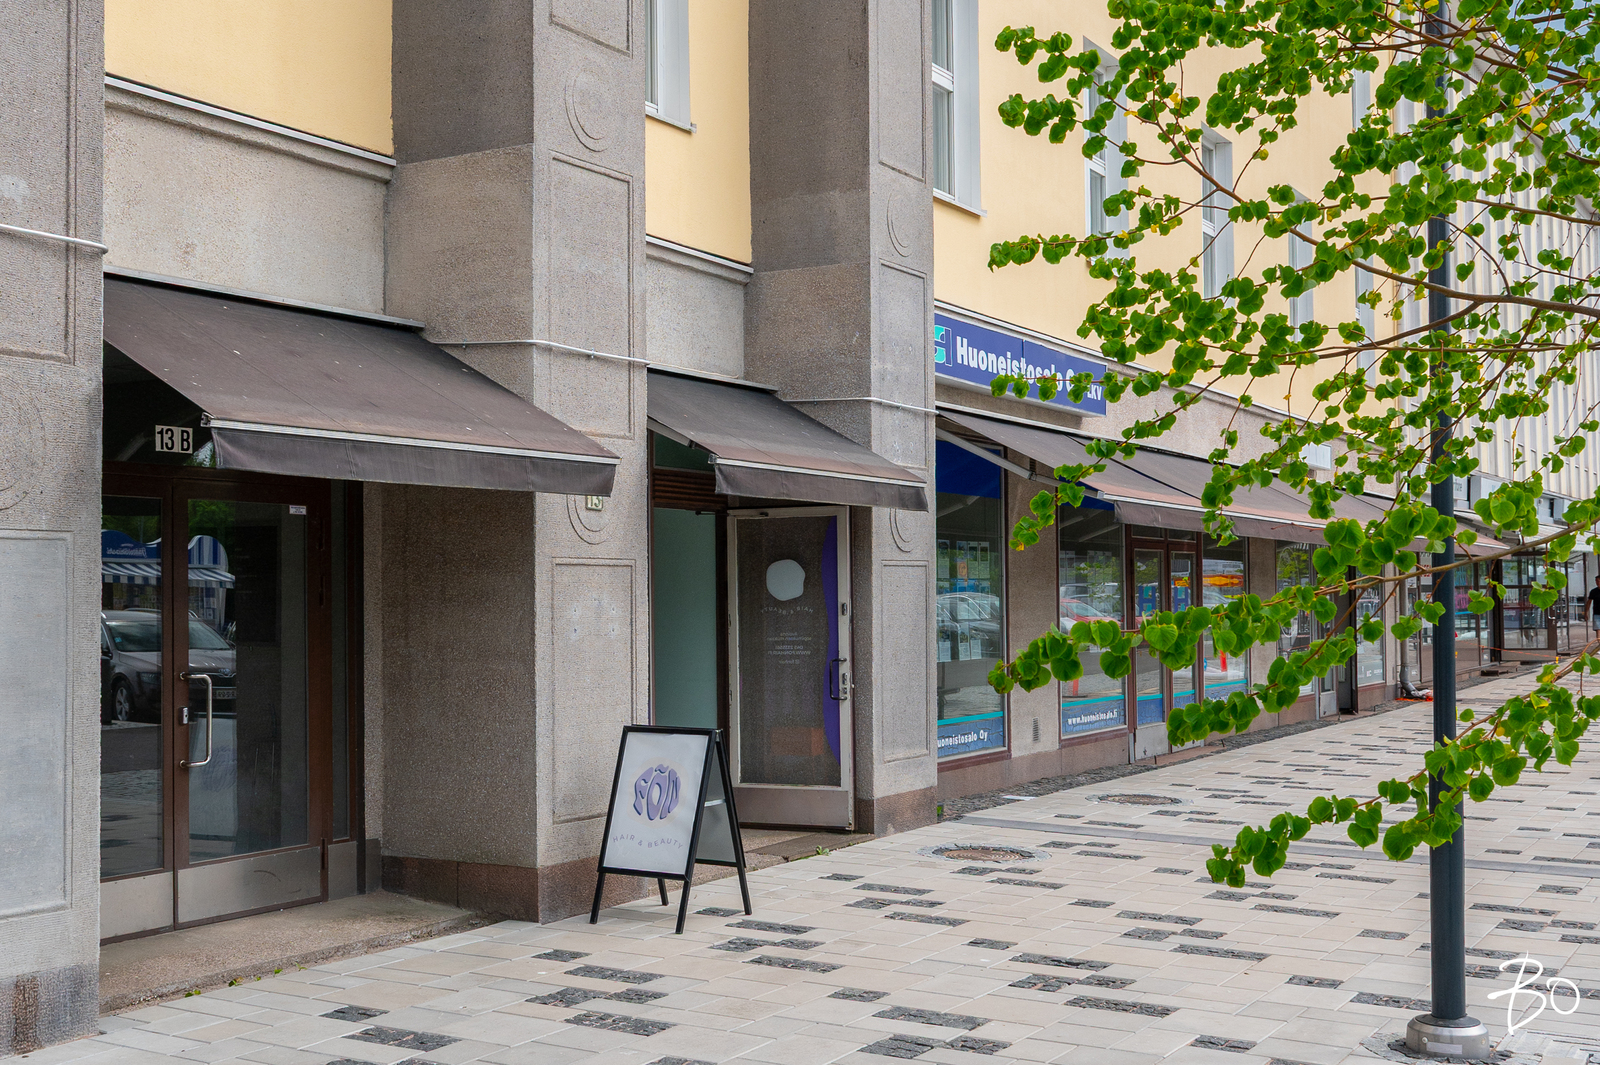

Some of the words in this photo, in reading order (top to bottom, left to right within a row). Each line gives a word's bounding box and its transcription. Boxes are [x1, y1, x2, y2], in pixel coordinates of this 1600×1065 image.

[157, 428, 175, 451] 13
[180, 429, 191, 452] B
[1067, 709, 1117, 725] www.huoneistosalo.fi
[937, 731, 978, 748] uoneistosalo
[979, 729, 988, 742] Oy
[612, 833, 635, 843] HAIR
[647, 837, 684, 850] BEAUTY
